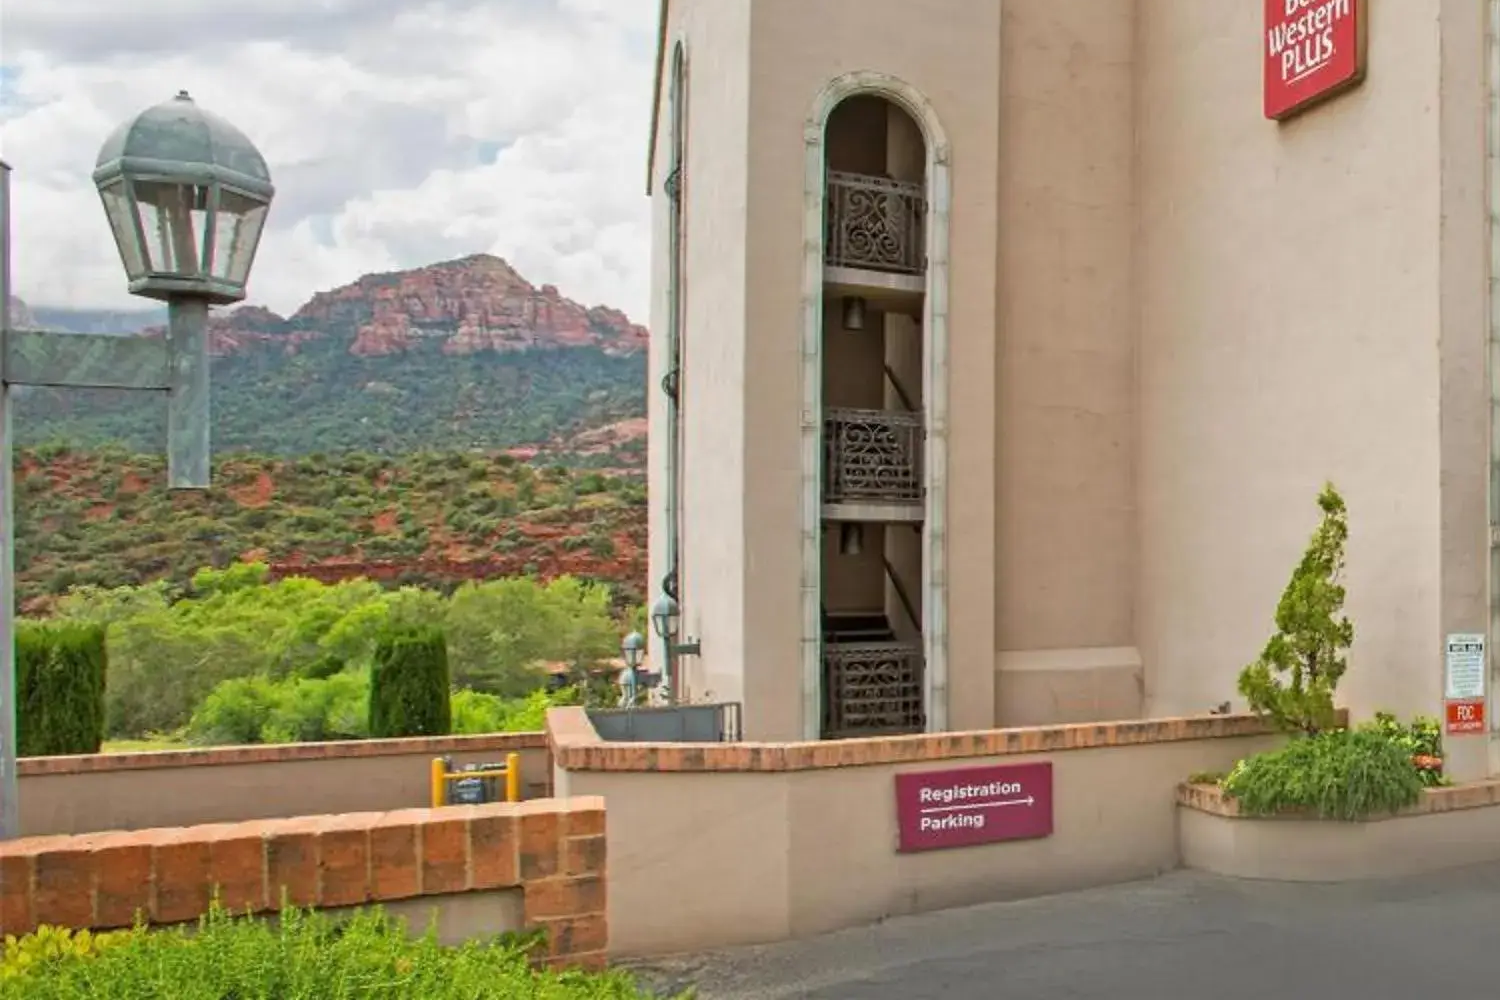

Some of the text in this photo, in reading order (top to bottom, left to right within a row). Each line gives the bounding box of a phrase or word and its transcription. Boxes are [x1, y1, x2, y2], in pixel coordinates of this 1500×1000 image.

[1282, 27, 1333, 80] PLUS
[919, 781, 1021, 803] Registration
[920, 813, 985, 831] Parking
